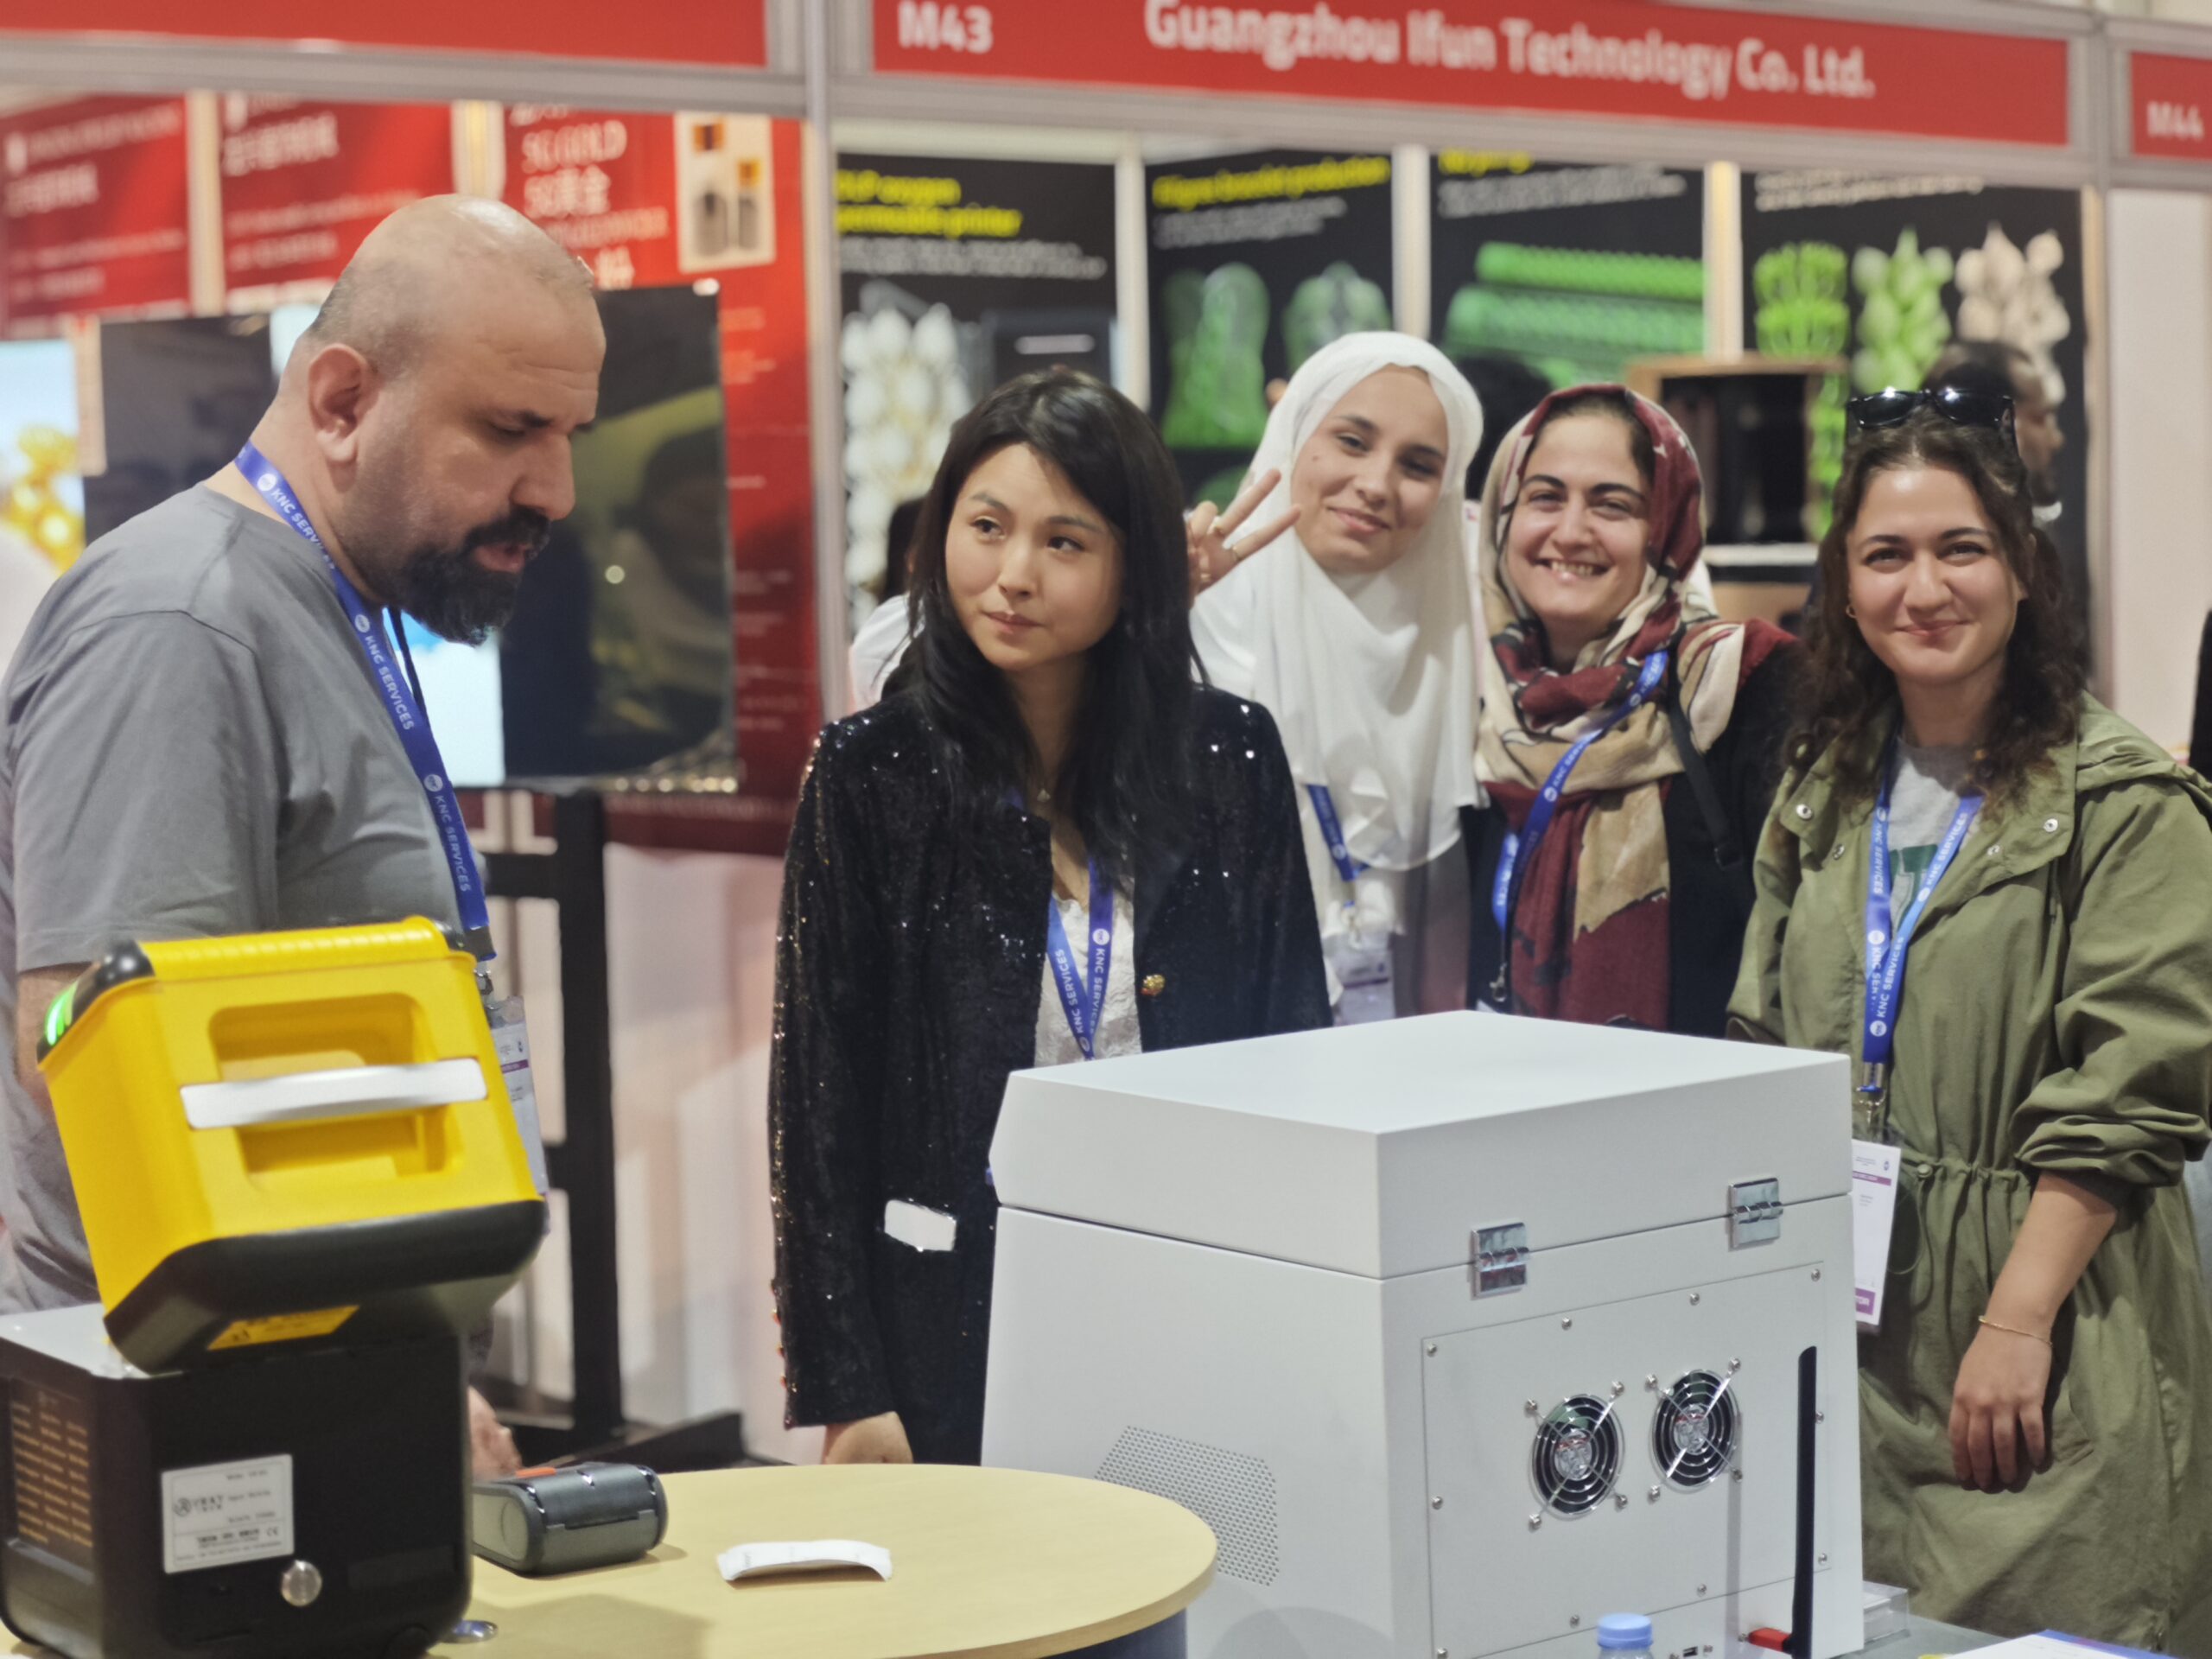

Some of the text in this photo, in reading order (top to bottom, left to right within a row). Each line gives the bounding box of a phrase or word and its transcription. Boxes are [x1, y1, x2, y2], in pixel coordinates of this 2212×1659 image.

[898, 1, 994, 54] M43
[1145, 0, 1401, 70] Guangzhou
[1501, 17, 1733, 100] Technology
[1736, 38, 1799, 91] Co.
[1803, 43, 1876, 99] Ltd.
[2146, 100, 2204, 141] M44
[271, 489, 296, 513] KNC
[365, 635, 415, 731] KNC SERVICES
[435, 795, 472, 892] KNC SERVICES
[1054, 949, 1084, 1033] KNC SERVICES
[1094, 948, 1106, 974] KNC
[1876, 936, 1904, 1019] KNC SERVICES
